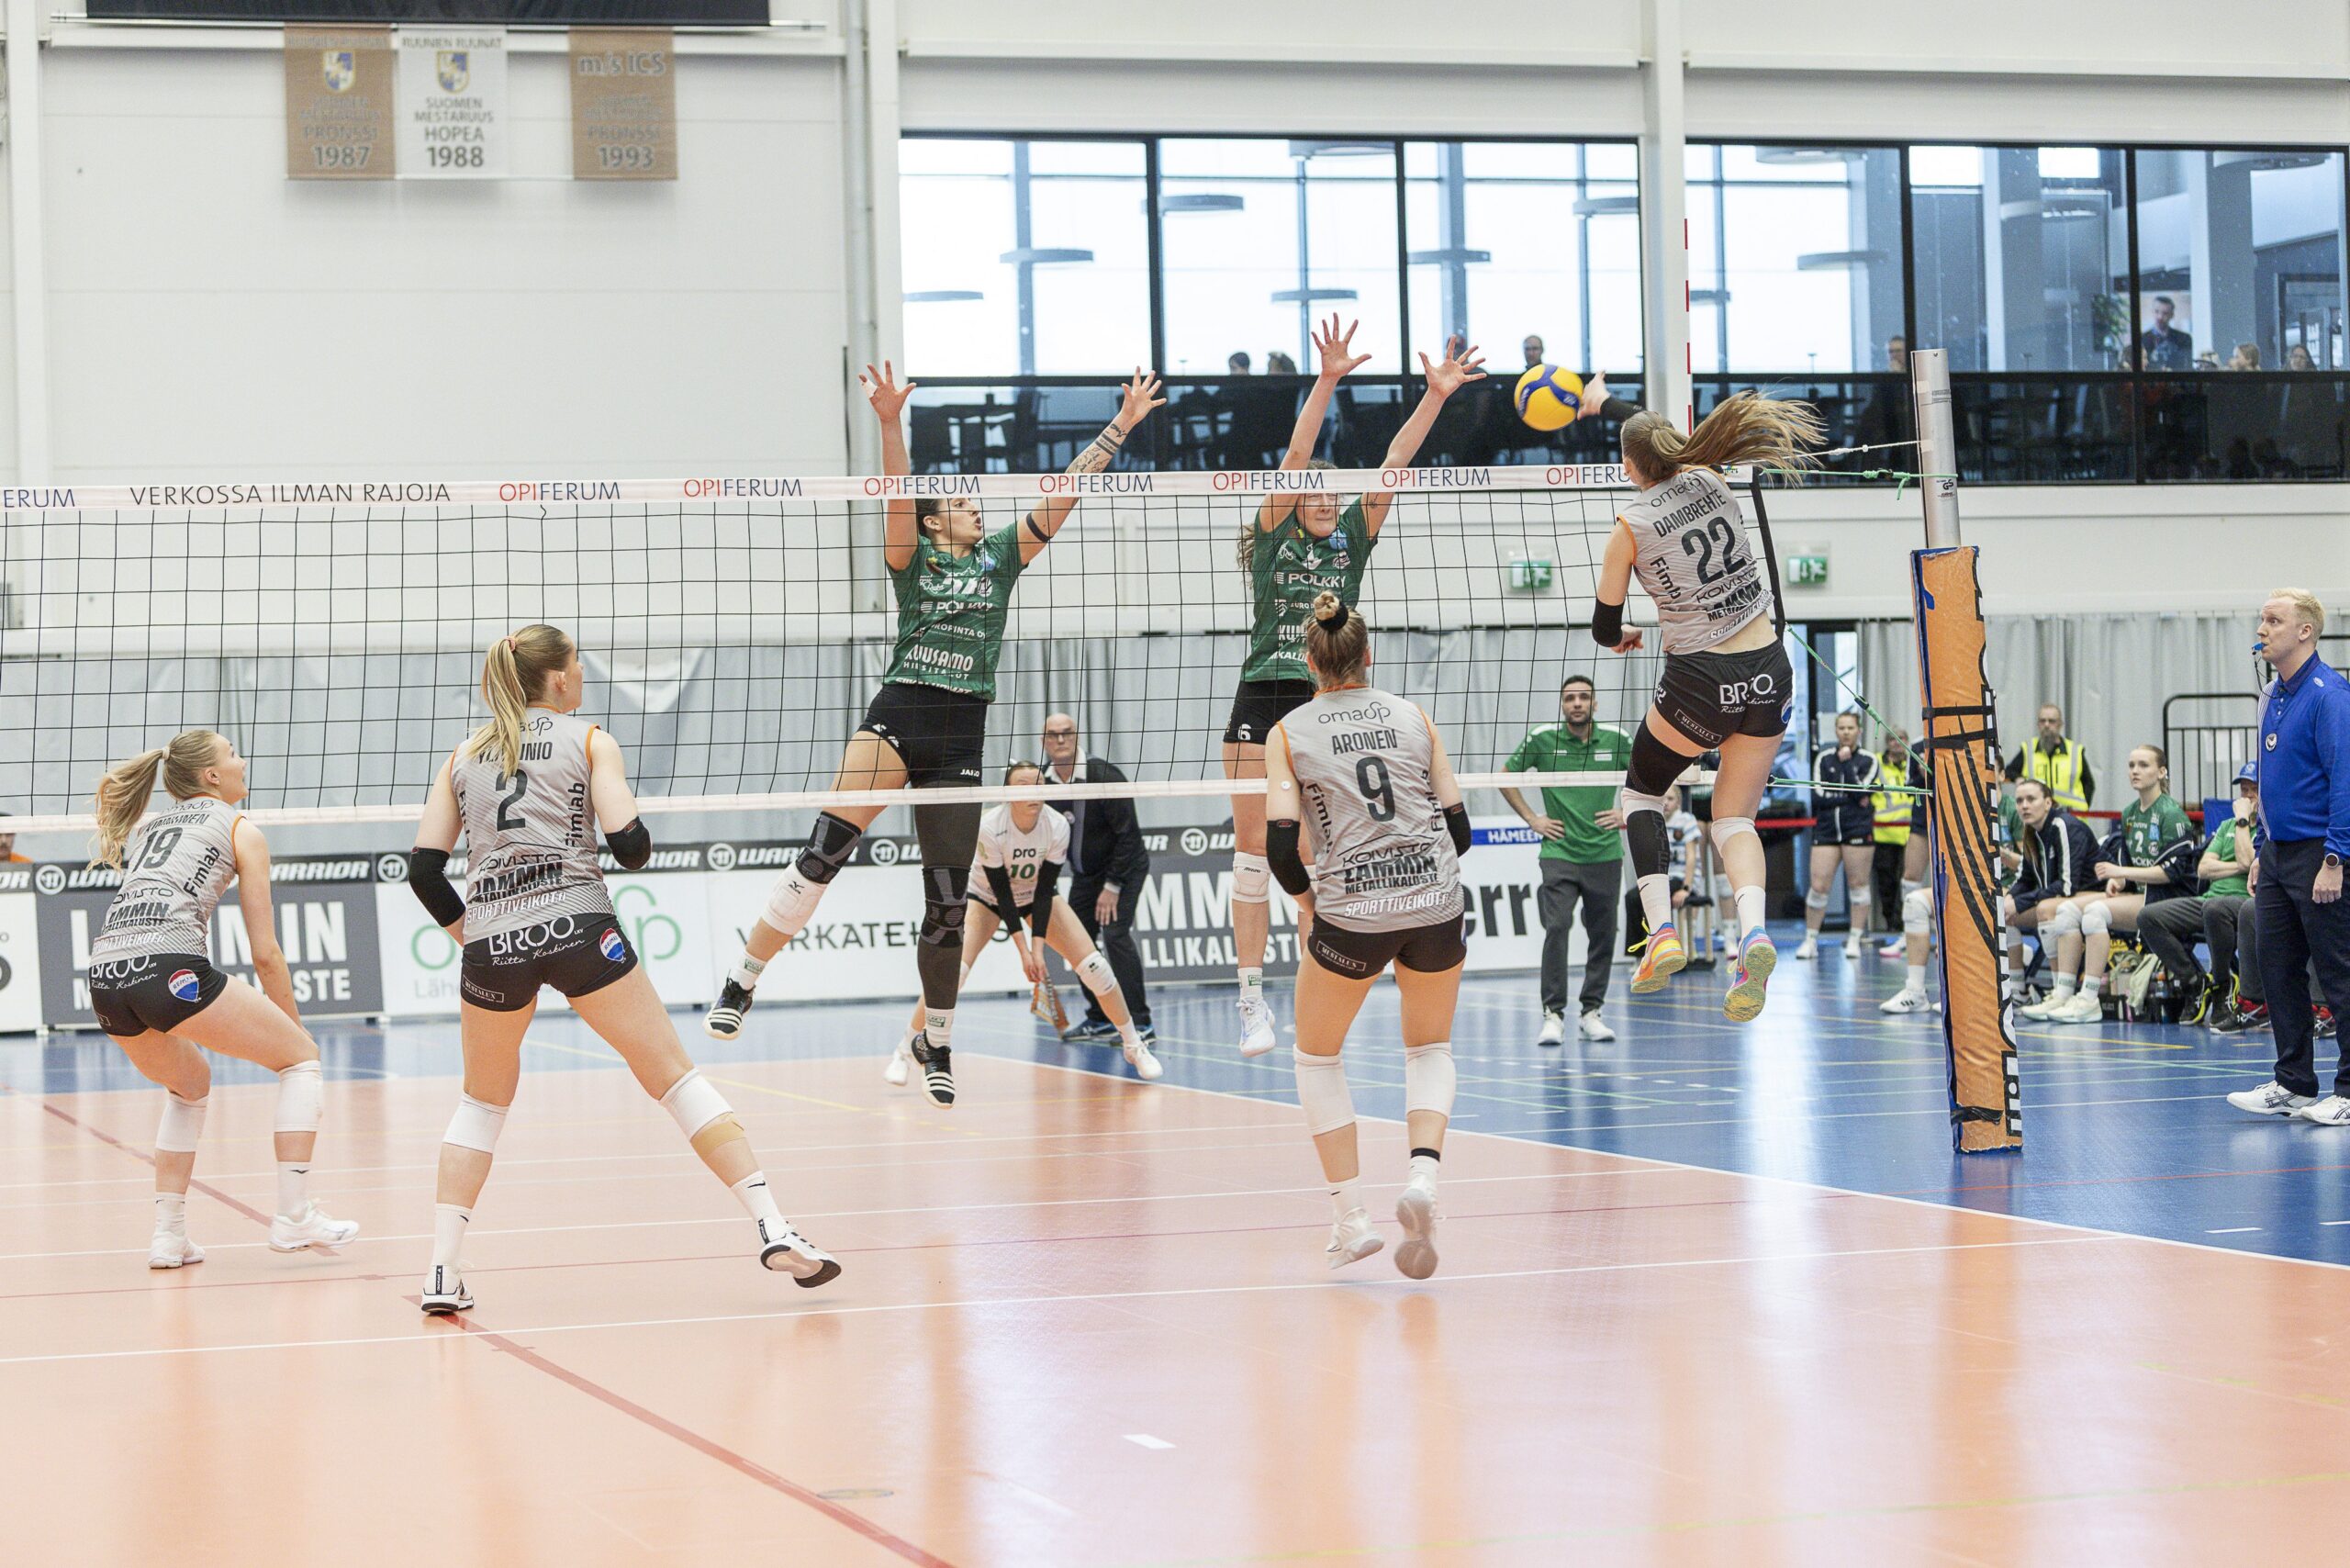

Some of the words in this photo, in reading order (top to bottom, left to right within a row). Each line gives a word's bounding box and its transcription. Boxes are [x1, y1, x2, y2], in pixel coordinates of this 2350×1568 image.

[628, 52, 666, 74] ICS
[426, 97, 482, 109] SUOMEN
[414, 111, 494, 123] MESTARUUS
[424, 127, 485, 141] HOPEA
[314, 146, 371, 168] 1987
[426, 146, 485, 168] 1988
[599, 147, 654, 168] 1993
[864, 475, 981, 495] OPIFERUM
[1039, 473, 1154, 493] OPIFERUM
[1213, 471, 1325, 491] OPIFERUM
[1382, 467, 1492, 488] OPIFERUM
[1546, 465, 1631, 485] OPIFERU
[4, 488, 76, 508] ERUM
[129, 485, 263, 506] VERKOSSA
[271, 483, 353, 504] ILMAN
[363, 482, 451, 503] RAJOJA
[498, 480, 621, 502] OPIFERUM
[684, 477, 803, 498] OPIFERUM
[1681, 516, 1747, 585] 22
[1237, 723, 1252, 741] 6
[1332, 728, 1398, 756] ARONEN
[495, 768, 529, 832] 2
[1355, 756, 1395, 823] 9
[131, 826, 184, 873] 19
[2134, 830, 2144, 854] 2
[1013, 847, 1036, 860] pro
[1342, 843, 1430, 868] KOIVISTO
[184, 846, 221, 898] Fimlab
[270, 860, 371, 881] ARRIOR
[474, 861, 563, 896] AMMIN
[1010, 863, 1036, 879] 10
[1344, 855, 1438, 884] LAMMIN
[1345, 873, 1439, 895] METALLIKALUSTE
[112, 887, 173, 905] OIVISTO
[108, 902, 171, 924] AMMIN
[492, 957, 527, 966] Riitta
[533, 938, 586, 959] Koskinen
[116, 972, 159, 990] Koskinen
